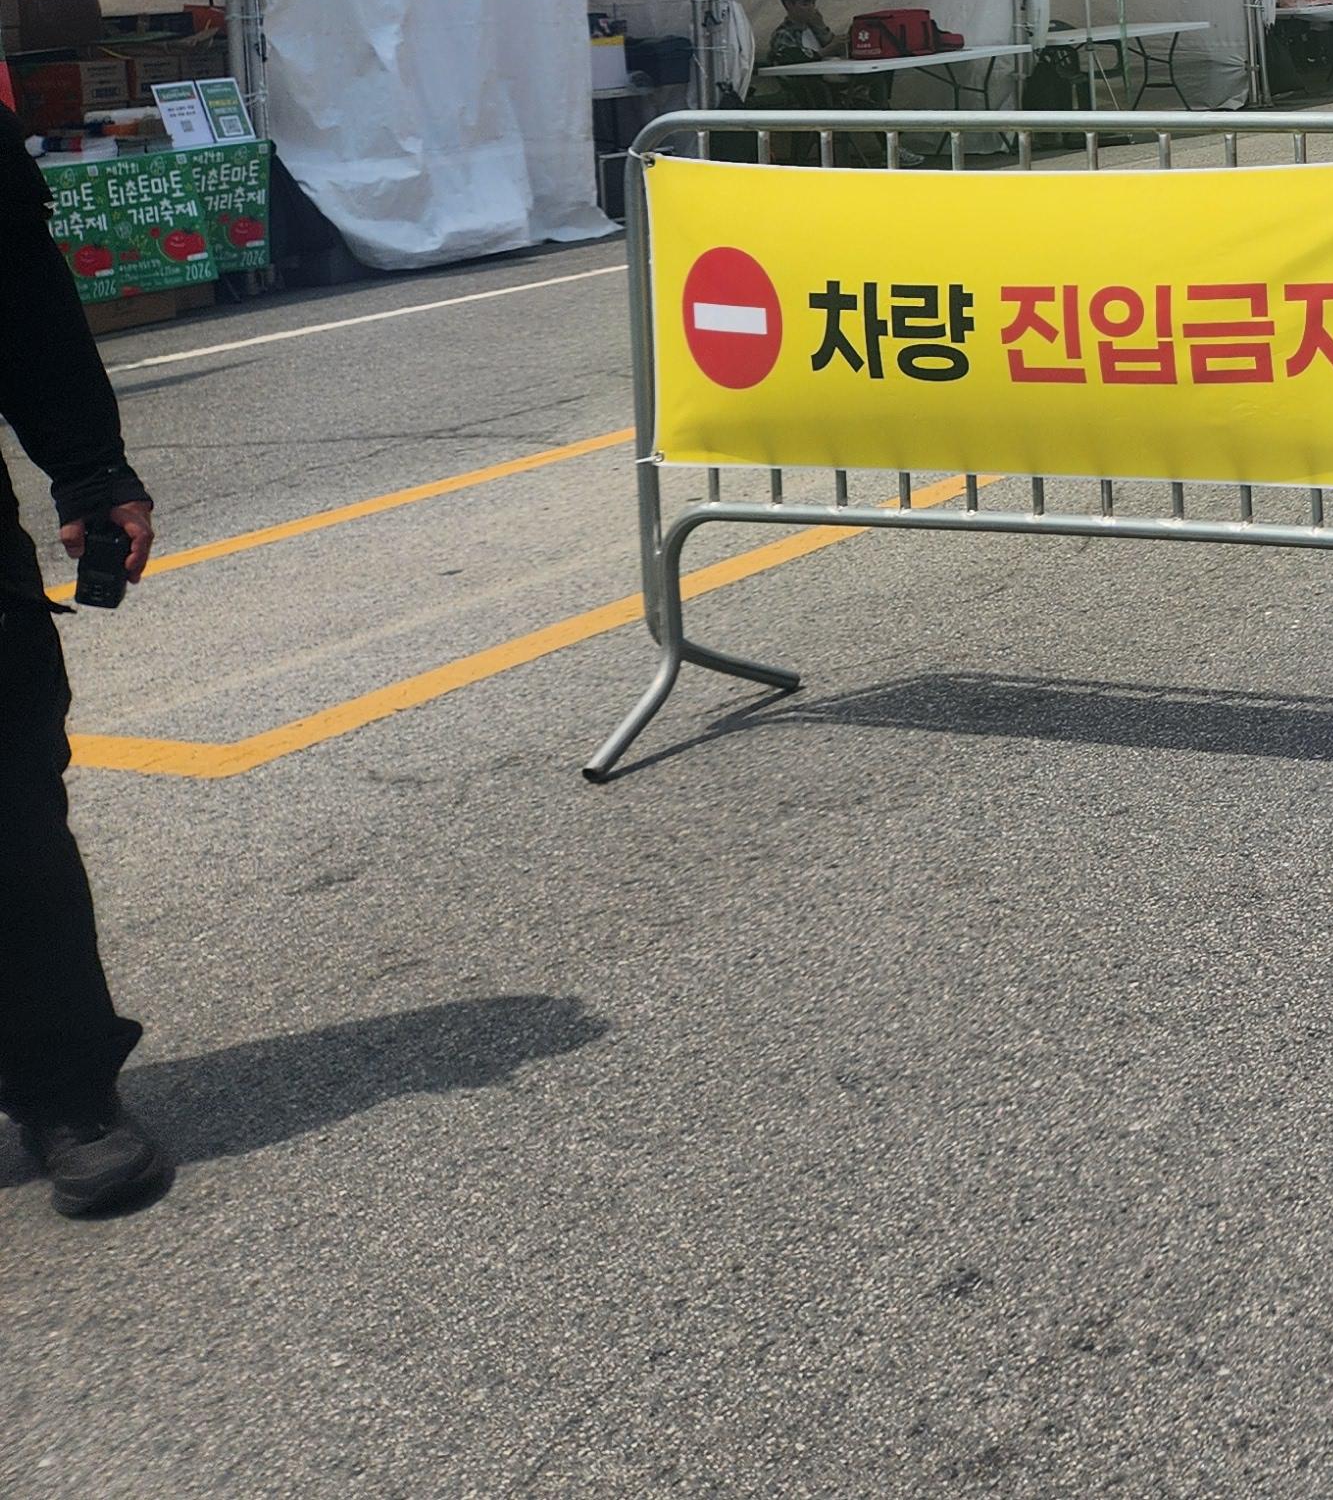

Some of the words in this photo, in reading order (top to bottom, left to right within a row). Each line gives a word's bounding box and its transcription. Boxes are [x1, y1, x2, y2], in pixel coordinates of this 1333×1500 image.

[127, 198, 199, 227] 거리축제
[204, 186, 267, 214] 거리축제
[49, 211, 108, 241] 리축제
[185, 263, 213, 282] 2026
[808, 279, 974, 382] 차량
